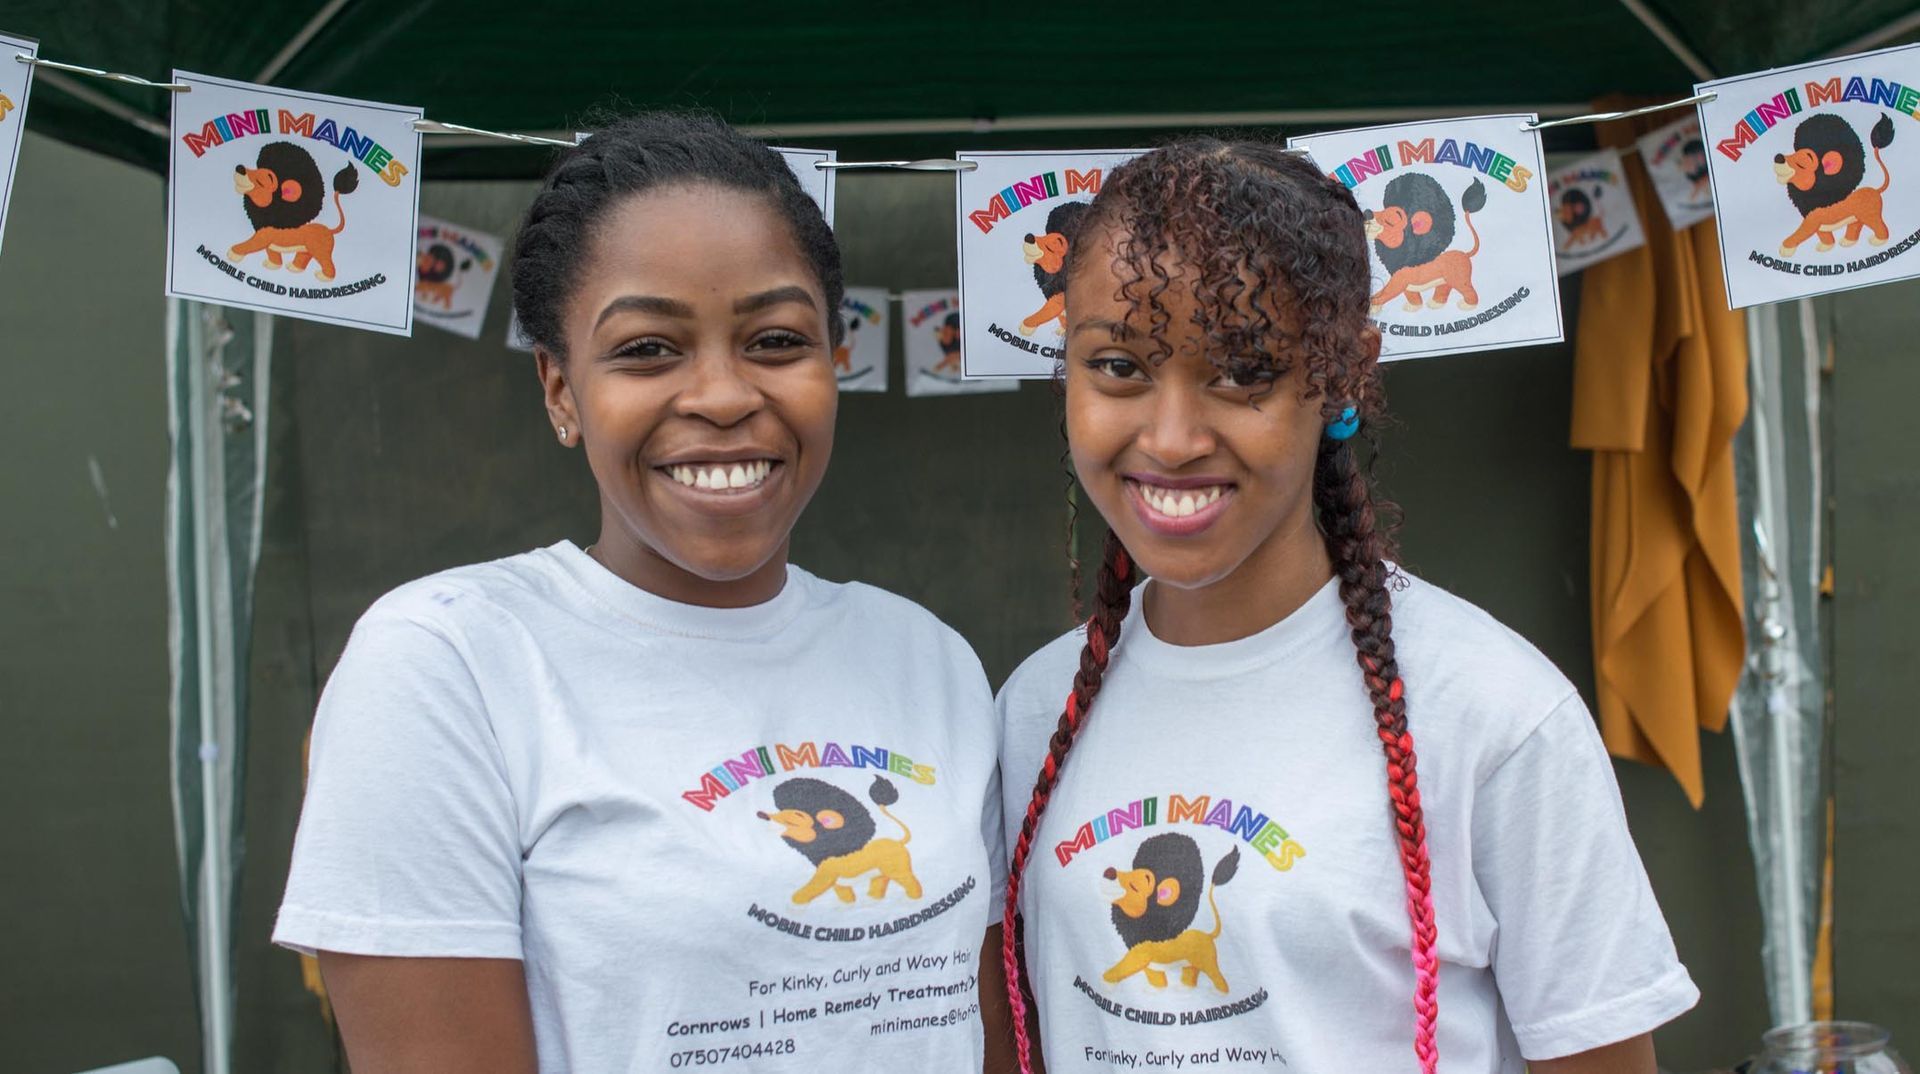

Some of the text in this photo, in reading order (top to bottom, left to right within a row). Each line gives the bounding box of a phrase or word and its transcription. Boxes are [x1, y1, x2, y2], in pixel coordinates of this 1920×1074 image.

[1716, 87, 1802, 162] MINI
[1805, 76, 1920, 122] MANE
[182, 109, 409, 187] MINI MANES
[1326, 144, 1394, 190] INI
[1397, 138, 1533, 193] MANES
[968, 171, 1059, 234] MINI
[196, 244, 387, 299] MOBILE CHILD HAIRDRESSING
[1748, 228, 1920, 276] MOBILE CHILD HAIRDRESSI
[1389, 323, 1432, 336] CHILD
[1434, 286, 1531, 335] HAIRDRESSING
[988, 322, 1039, 354] MOBILE
[681, 741, 937, 812] MINI MANES
[1055, 794, 1306, 872] MINI MANES
[747, 875, 976, 942] MOBILE CHILD HAIRDRESSING
[748, 980, 776, 998] For
[782, 973, 828, 992] Kinky,
[833, 964, 871, 984] Curly
[875, 956, 901, 976] and
[906, 954, 948, 970] Wavy
[1073, 975, 1123, 1017] MOBILE
[1124, 1006, 1176, 1026] CHILD
[666, 1016, 750, 1037] Cornrows
[772, 1006, 817, 1024] Home
[824, 992, 881, 1016] Remedy
[670, 1038, 796, 1068] 07507404428
[1084, 1046, 1108, 1062] For
[1145, 1049, 1185, 1069] Curly
[1190, 1048, 1220, 1065] and
[1225, 1047, 1267, 1065] Wavy
